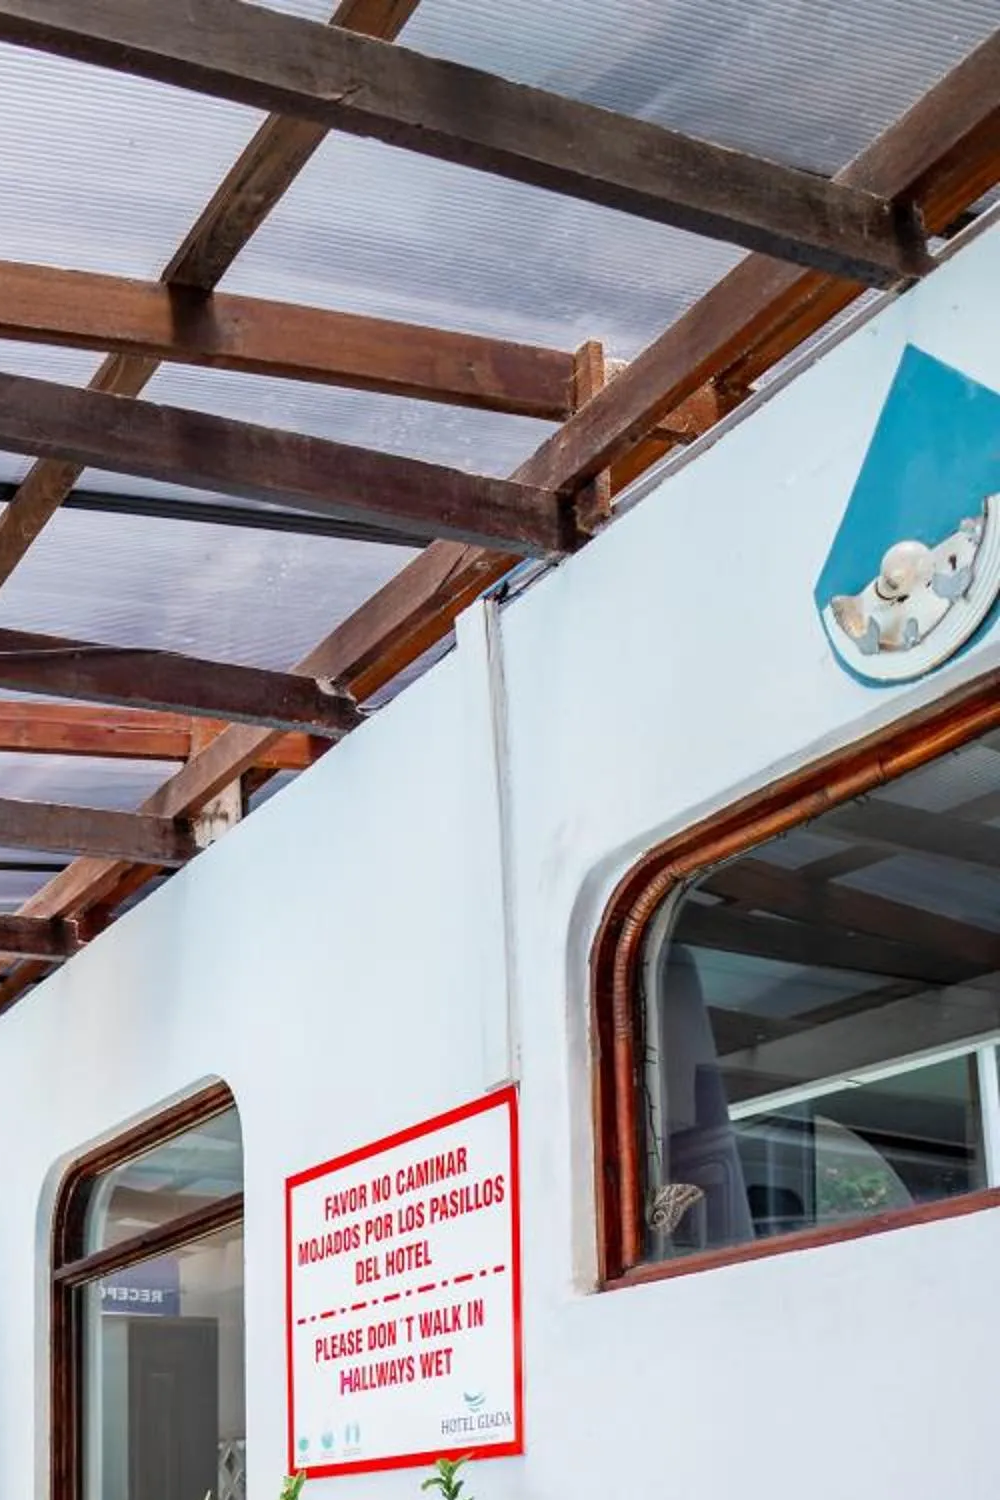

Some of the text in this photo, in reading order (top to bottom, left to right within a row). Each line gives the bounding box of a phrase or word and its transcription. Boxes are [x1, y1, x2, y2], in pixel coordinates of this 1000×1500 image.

[324, 1146, 467, 1222] FAVOR NO CAMINAR
[298, 1174, 505, 1267] MOJADOS POR LOS PASILLOS
[355, 1240, 432, 1286] DEL HOTEL
[315, 1328, 363, 1363] PLEASE
[419, 1304, 462, 1339] WALK
[467, 1299, 484, 1327] IN
[340, 1347, 453, 1395] HALLWAYS WET
[441, 1415, 474, 1435] HOTEL
